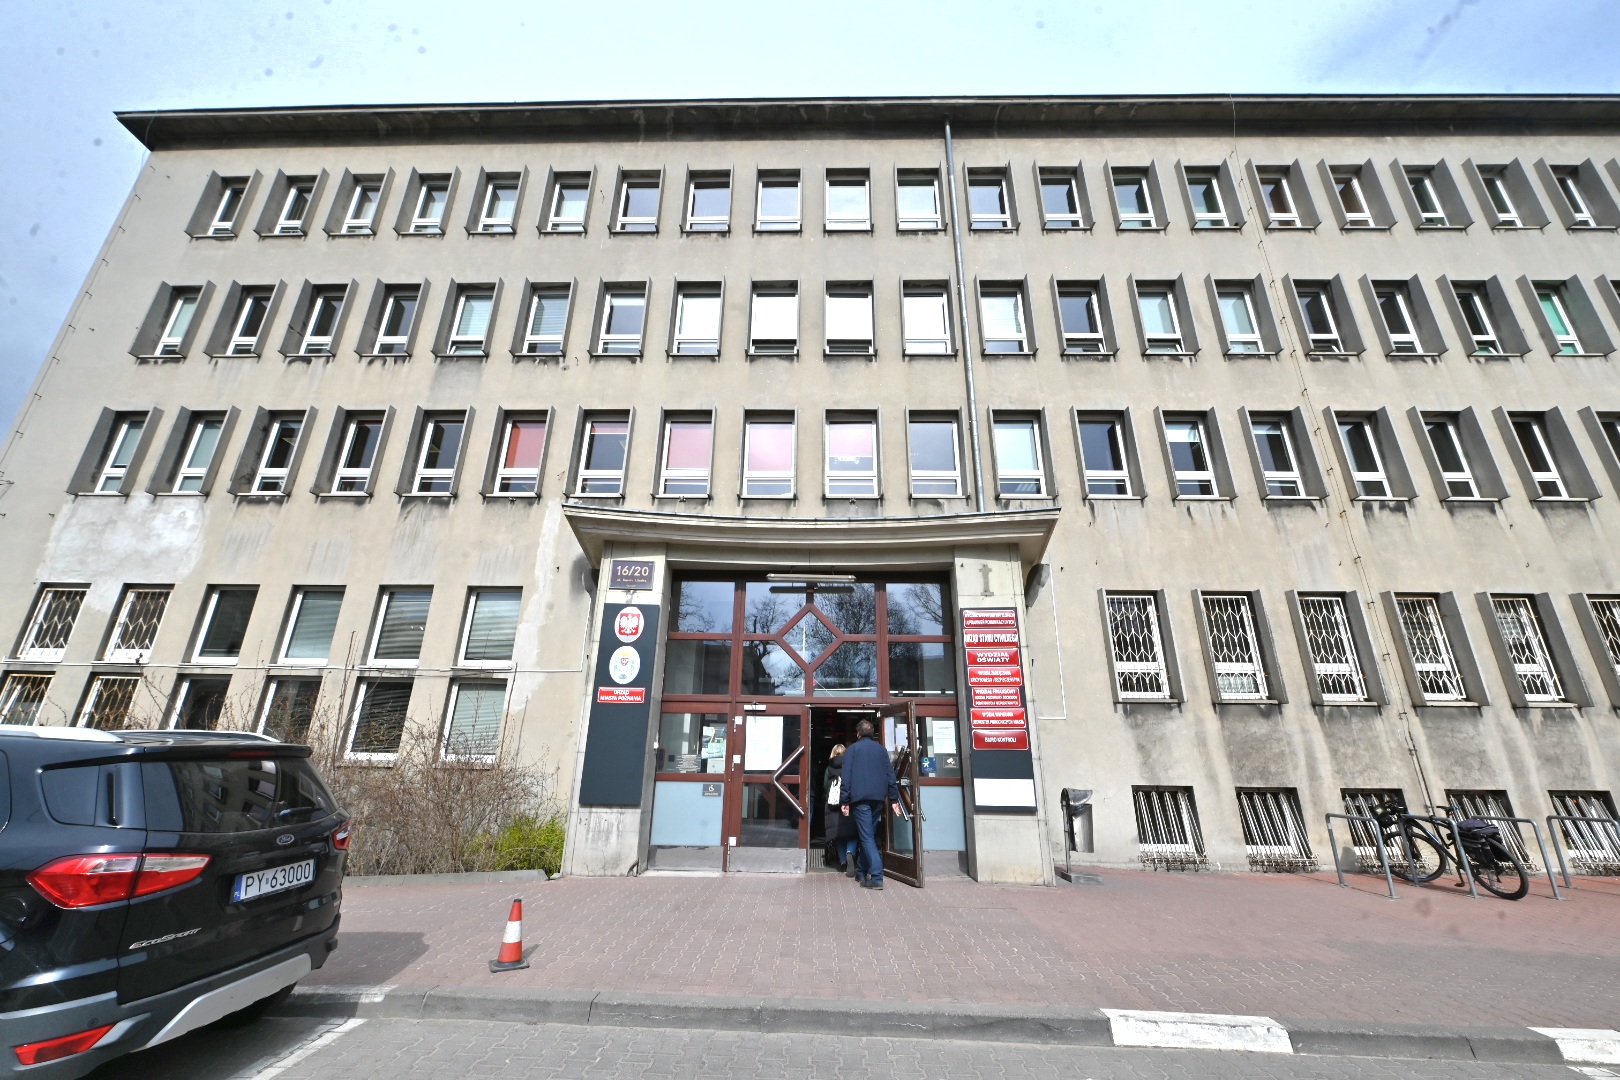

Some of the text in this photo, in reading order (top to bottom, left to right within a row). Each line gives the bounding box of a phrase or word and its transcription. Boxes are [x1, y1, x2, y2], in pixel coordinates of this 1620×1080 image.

[616, 566, 649, 576] 16/20
[245, 862, 311, 896] PY 63000
